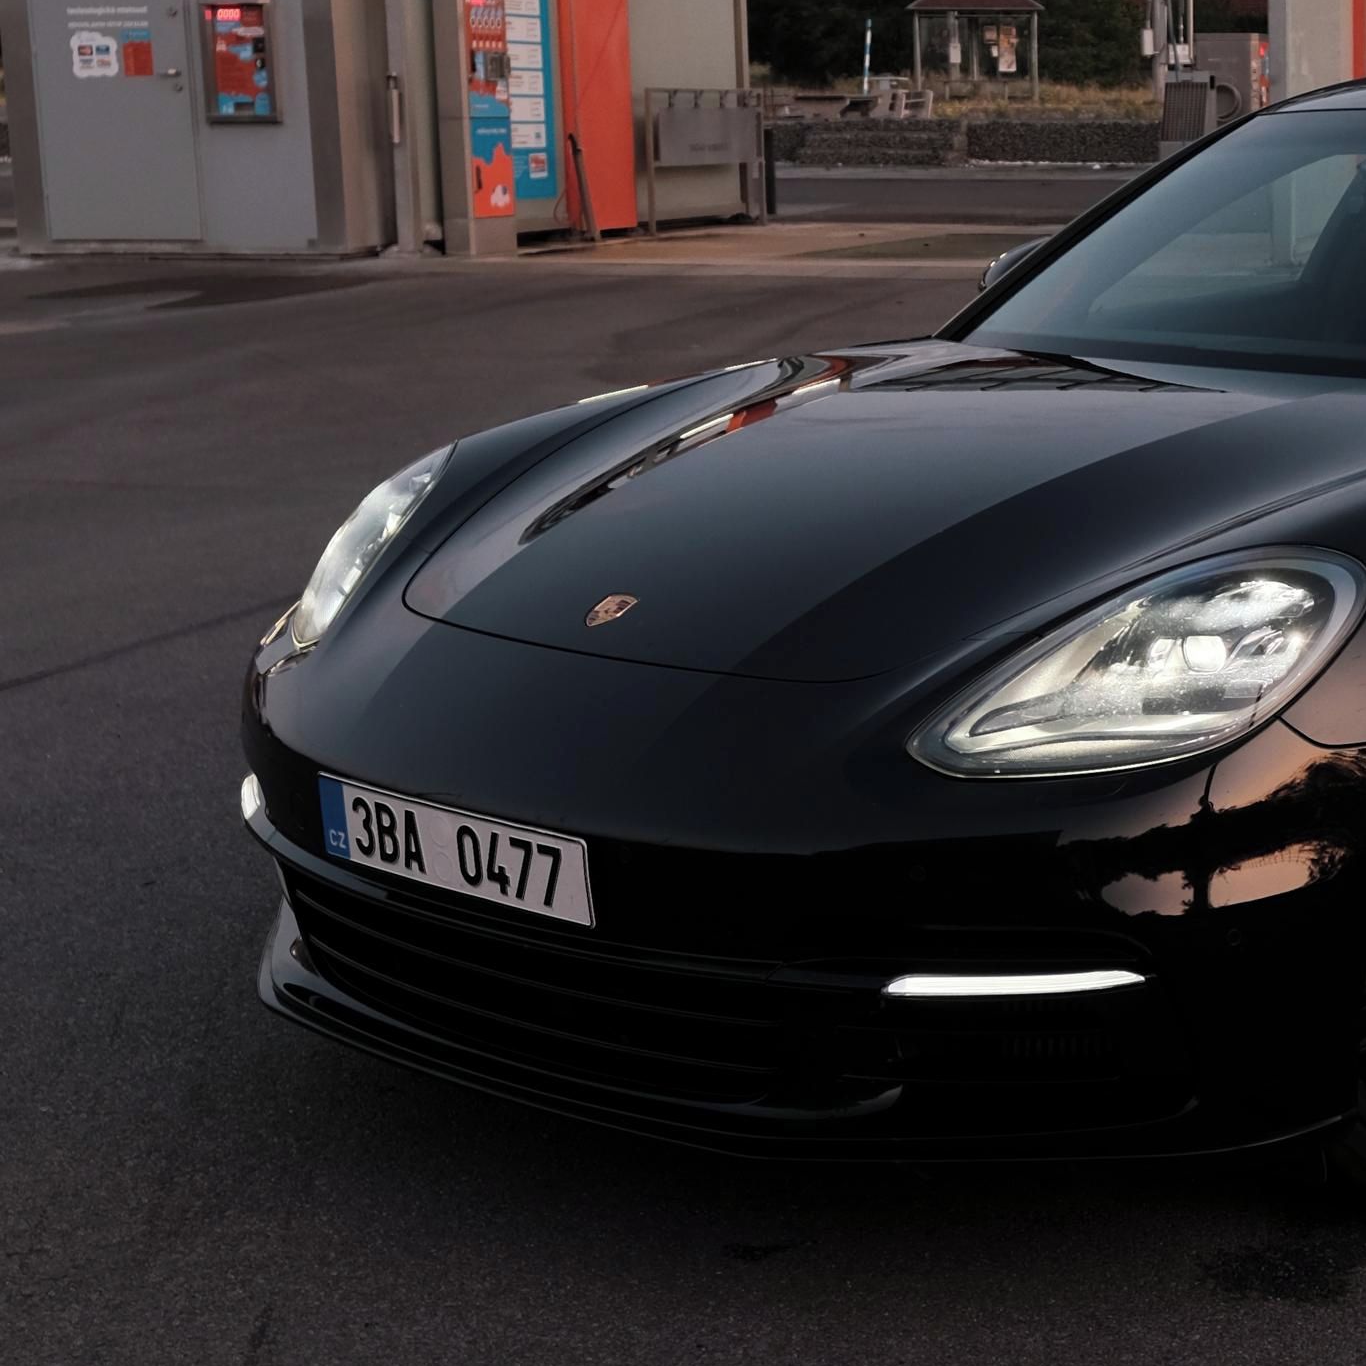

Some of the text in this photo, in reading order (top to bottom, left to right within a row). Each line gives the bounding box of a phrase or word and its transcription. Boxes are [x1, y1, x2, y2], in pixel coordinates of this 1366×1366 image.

[329, 829, 347, 850] CZ
[352, 796, 562, 908] 3BA 0477
